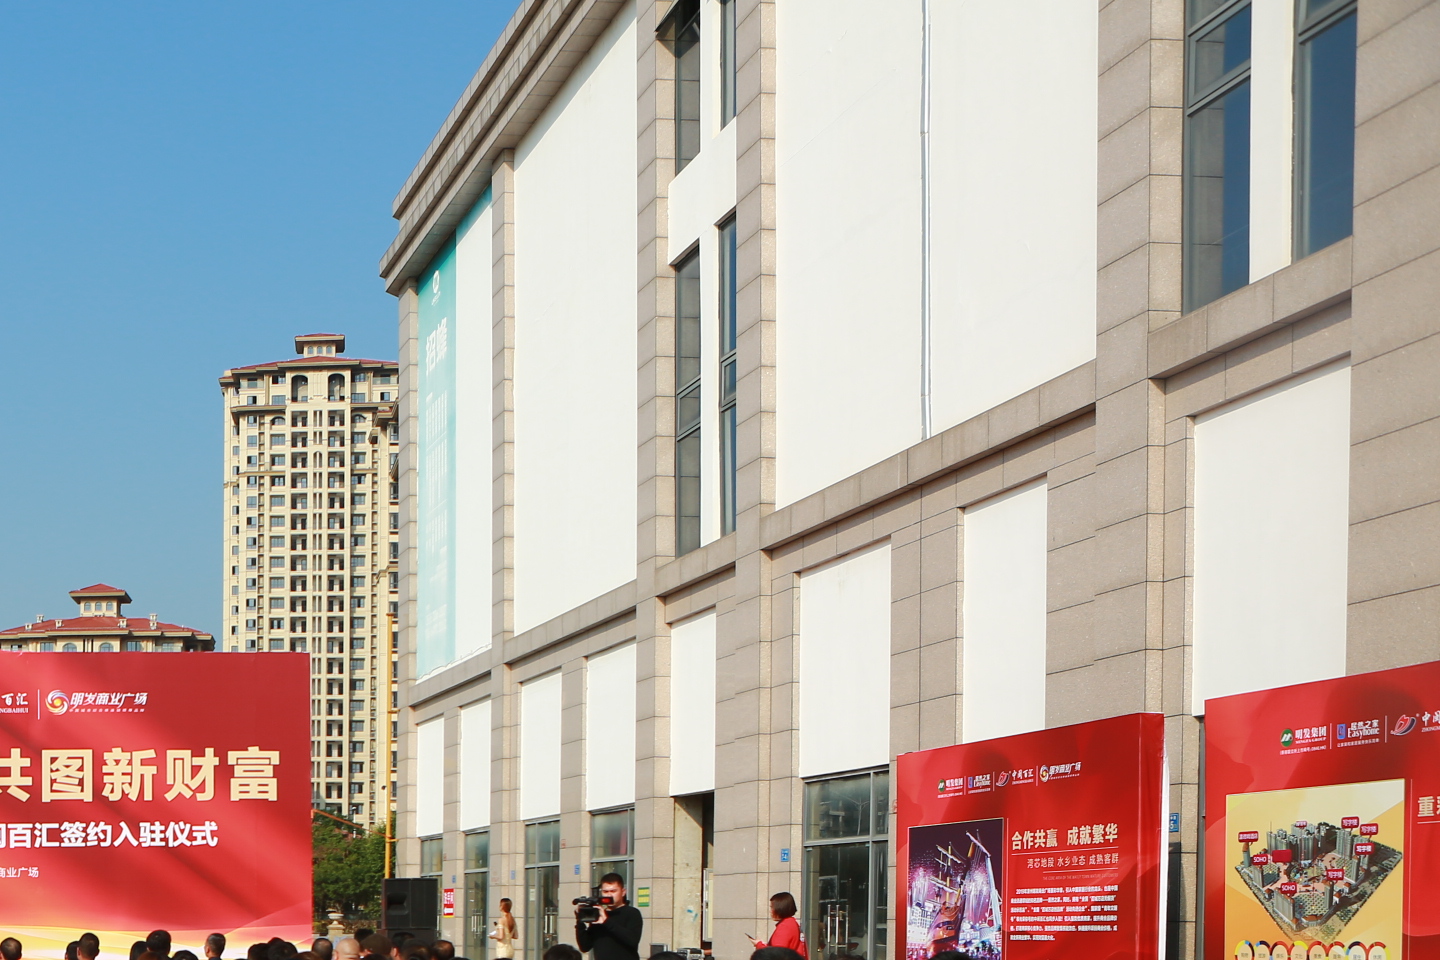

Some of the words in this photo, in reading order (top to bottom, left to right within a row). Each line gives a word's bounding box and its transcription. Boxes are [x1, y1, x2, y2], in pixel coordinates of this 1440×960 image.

[70, 692, 148, 708] 明发商业广场
[1295, 725, 1327, 740] 明发集团
[1011, 828, 1058, 851] 合作共赢
[1067, 823, 1118, 846] 成就繁华
[1057, 855, 1086, 867] 水乡业态
[1089, 853, 1119, 865] 成熟客群
